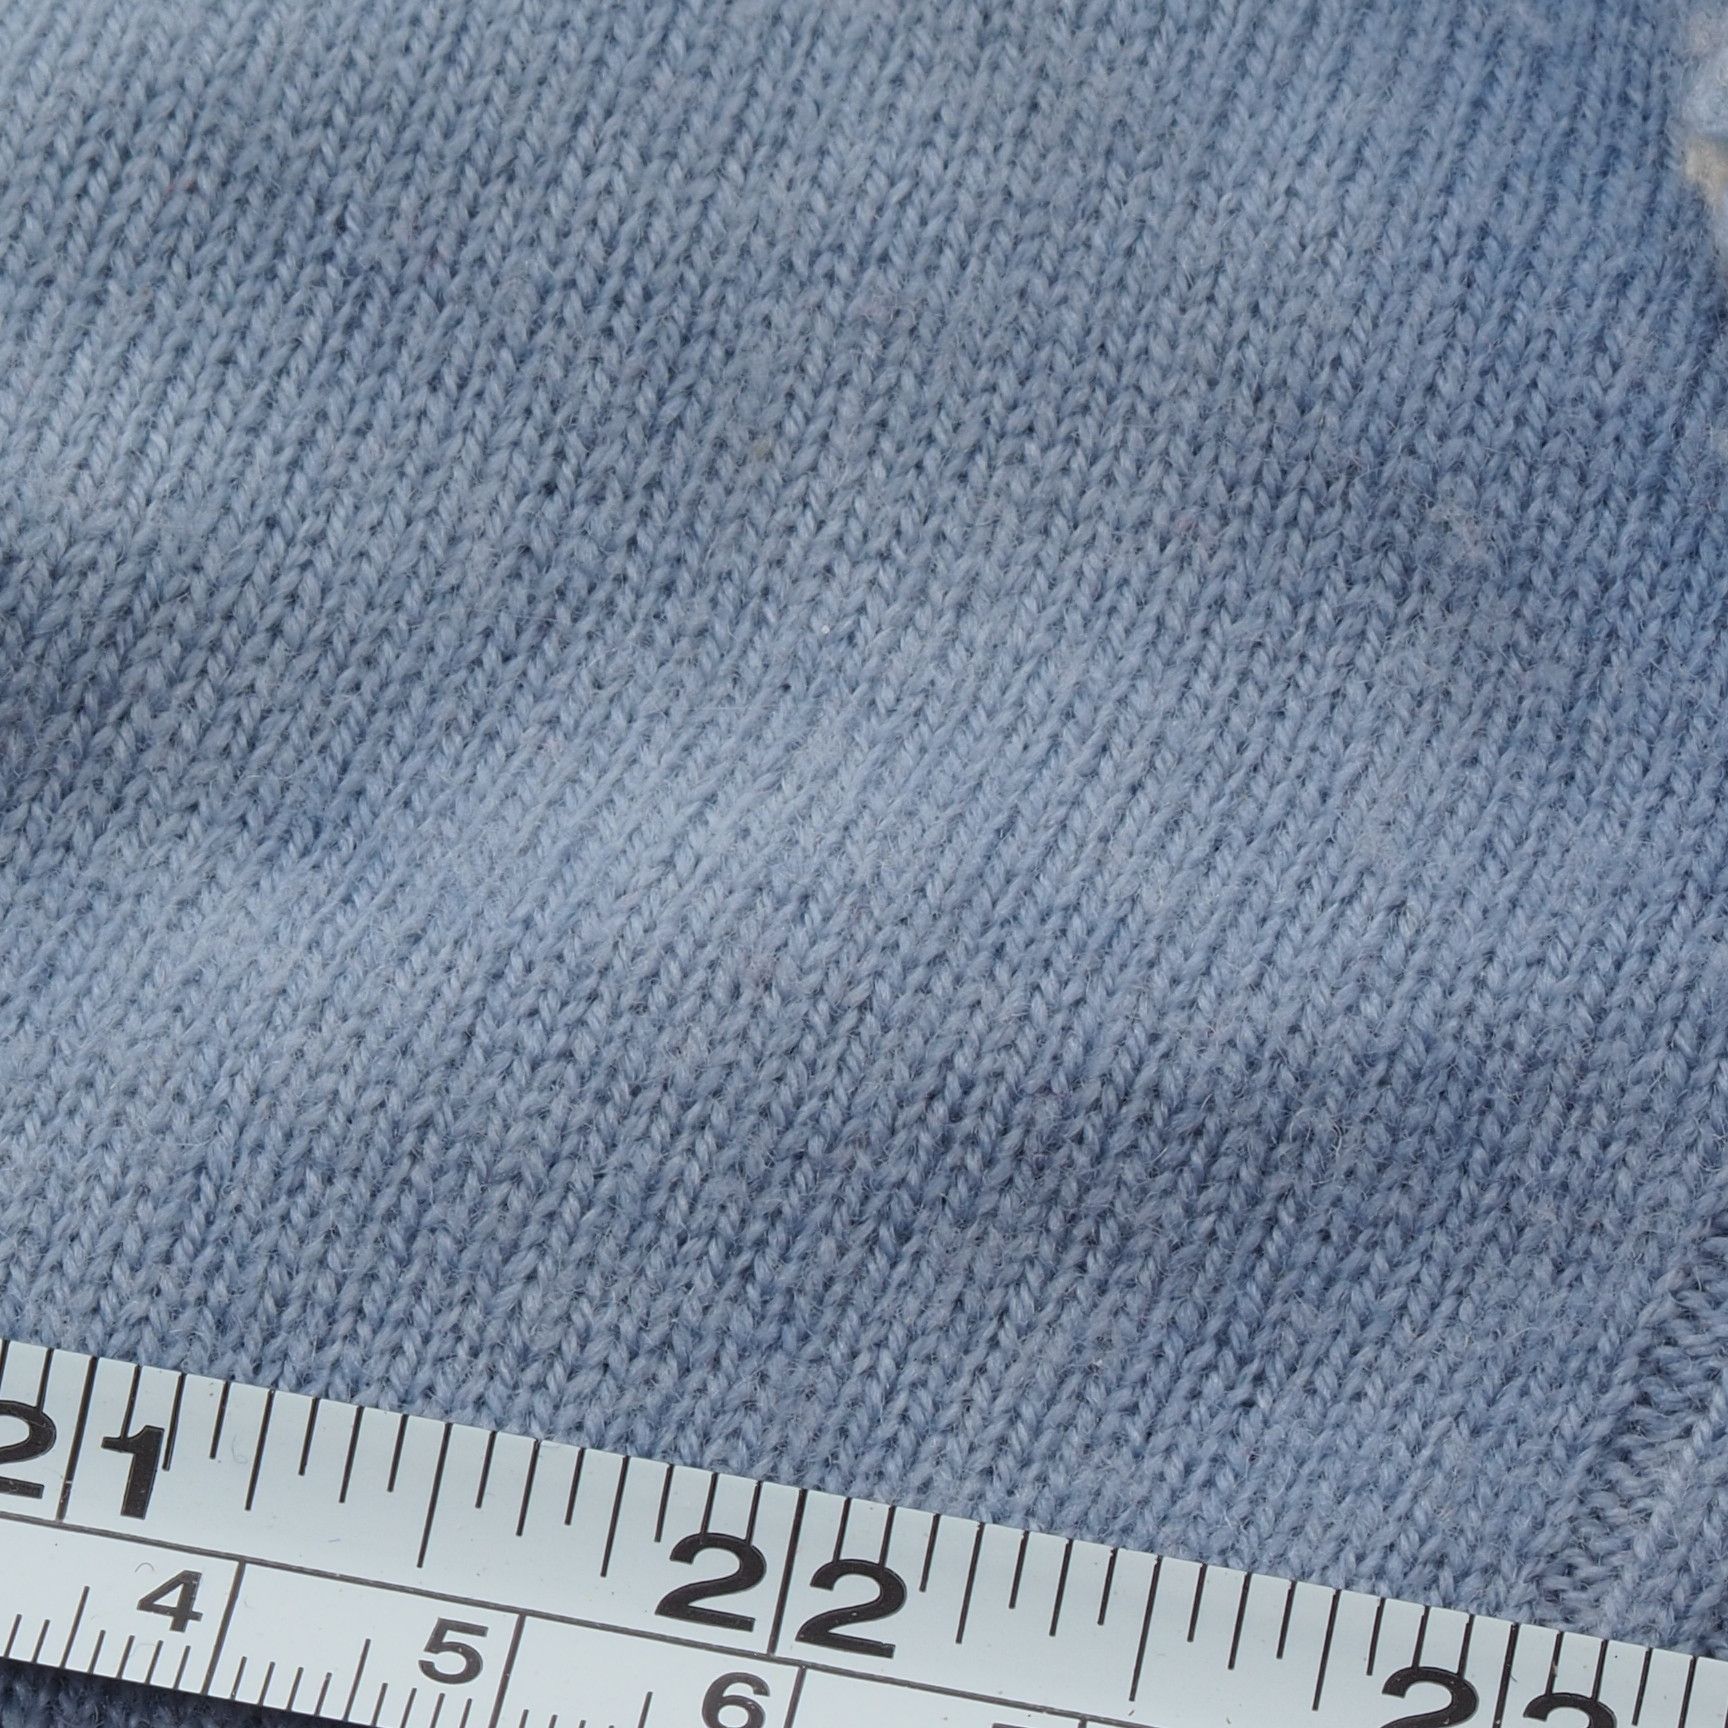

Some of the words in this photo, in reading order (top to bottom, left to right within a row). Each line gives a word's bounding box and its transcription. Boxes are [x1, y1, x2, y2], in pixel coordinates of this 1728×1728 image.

[136, 1570, 203, 1632] 4
[418, 1618, 489, 1685] 5
[655, 1532, 907, 1658] 22
